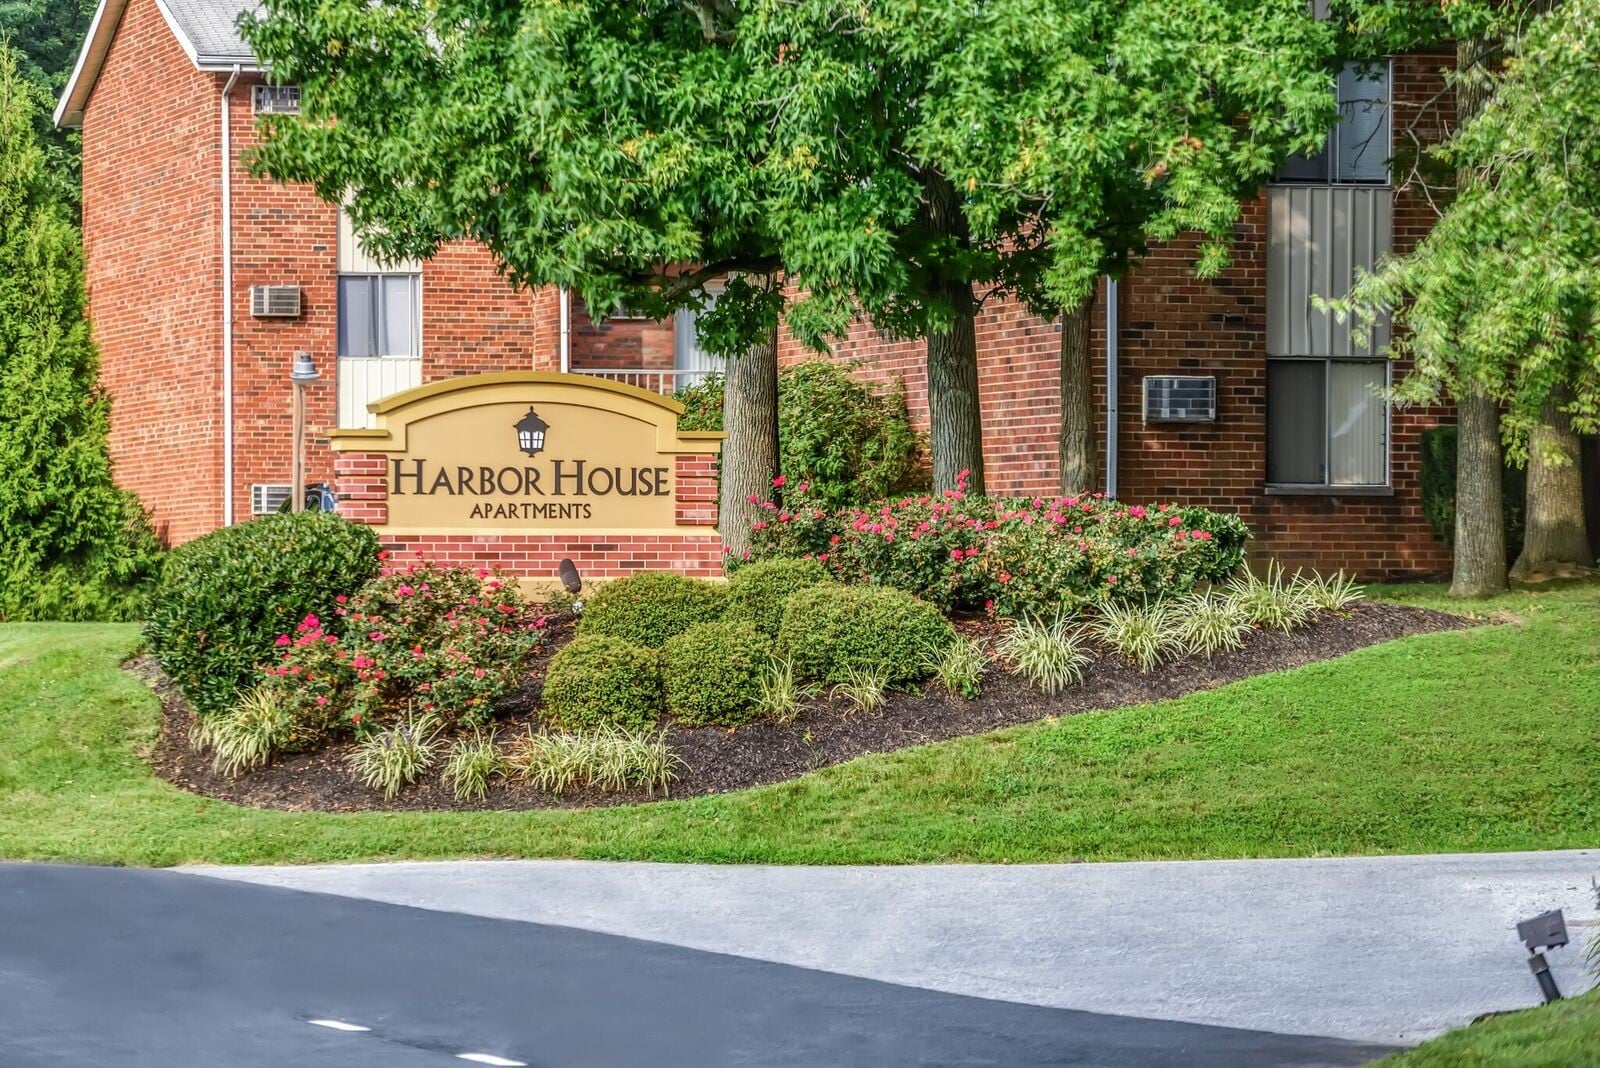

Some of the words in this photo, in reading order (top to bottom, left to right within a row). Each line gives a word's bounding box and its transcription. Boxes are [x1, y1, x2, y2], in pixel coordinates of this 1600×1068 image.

[390, 459, 545, 496] HARBOR
[550, 459, 671, 496] HOUSE
[469, 503, 592, 519] APARTMENTS
